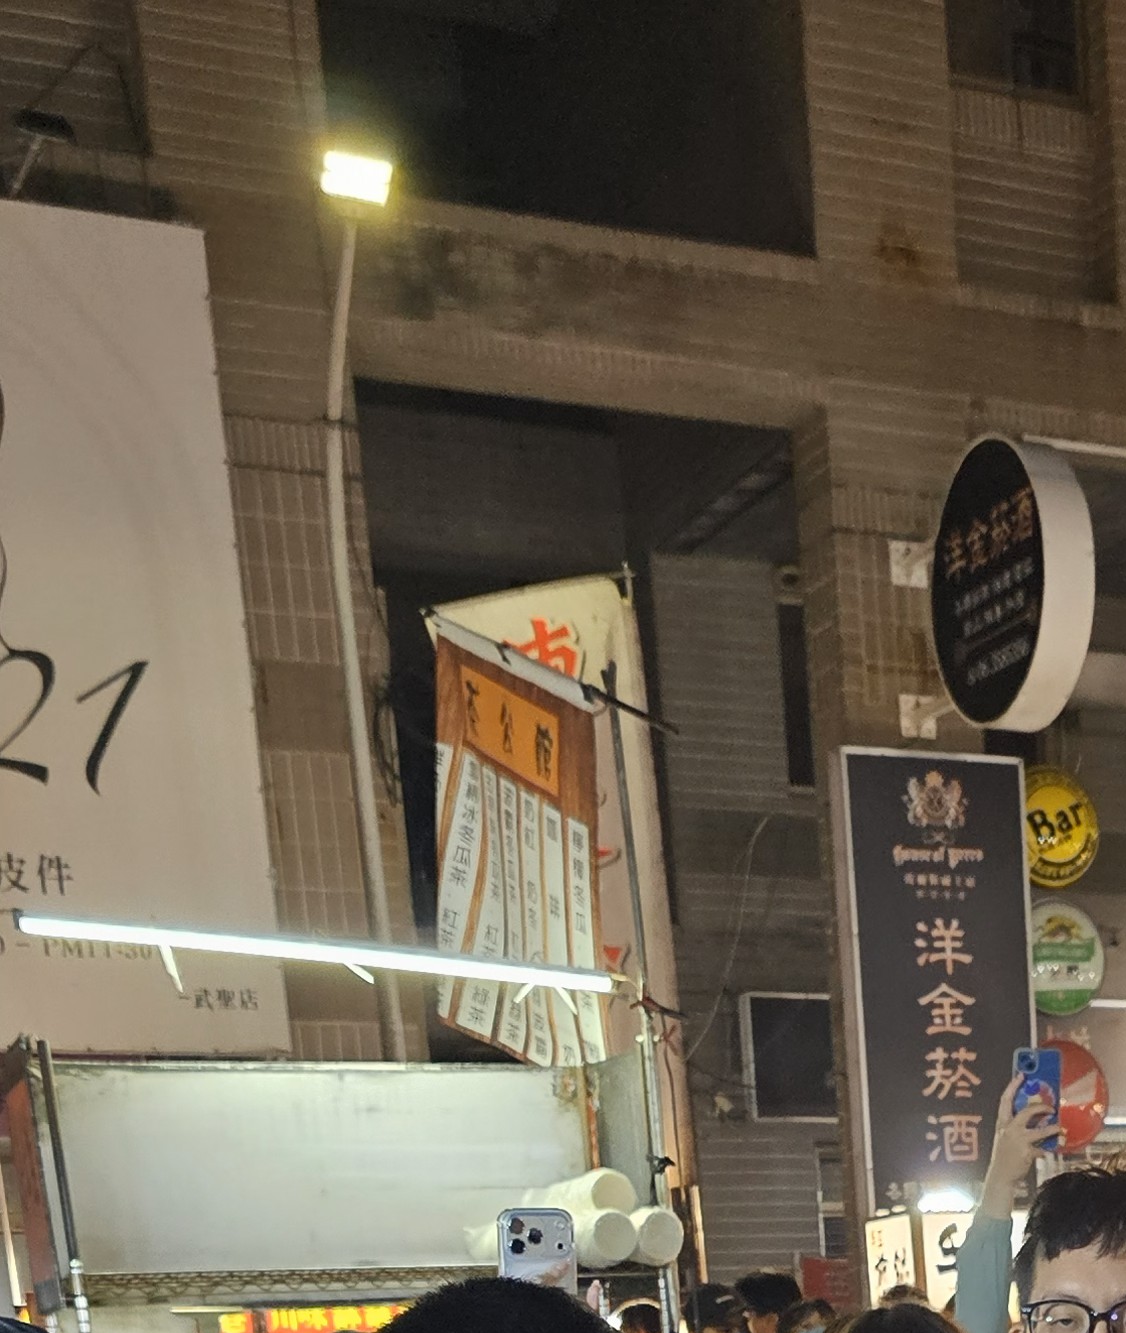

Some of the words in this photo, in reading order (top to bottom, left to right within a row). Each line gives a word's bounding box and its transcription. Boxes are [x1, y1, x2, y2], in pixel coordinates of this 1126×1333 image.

[1026, 802, 1082, 845] Bar
[913, 917, 982, 1161] 洋金菸酒
